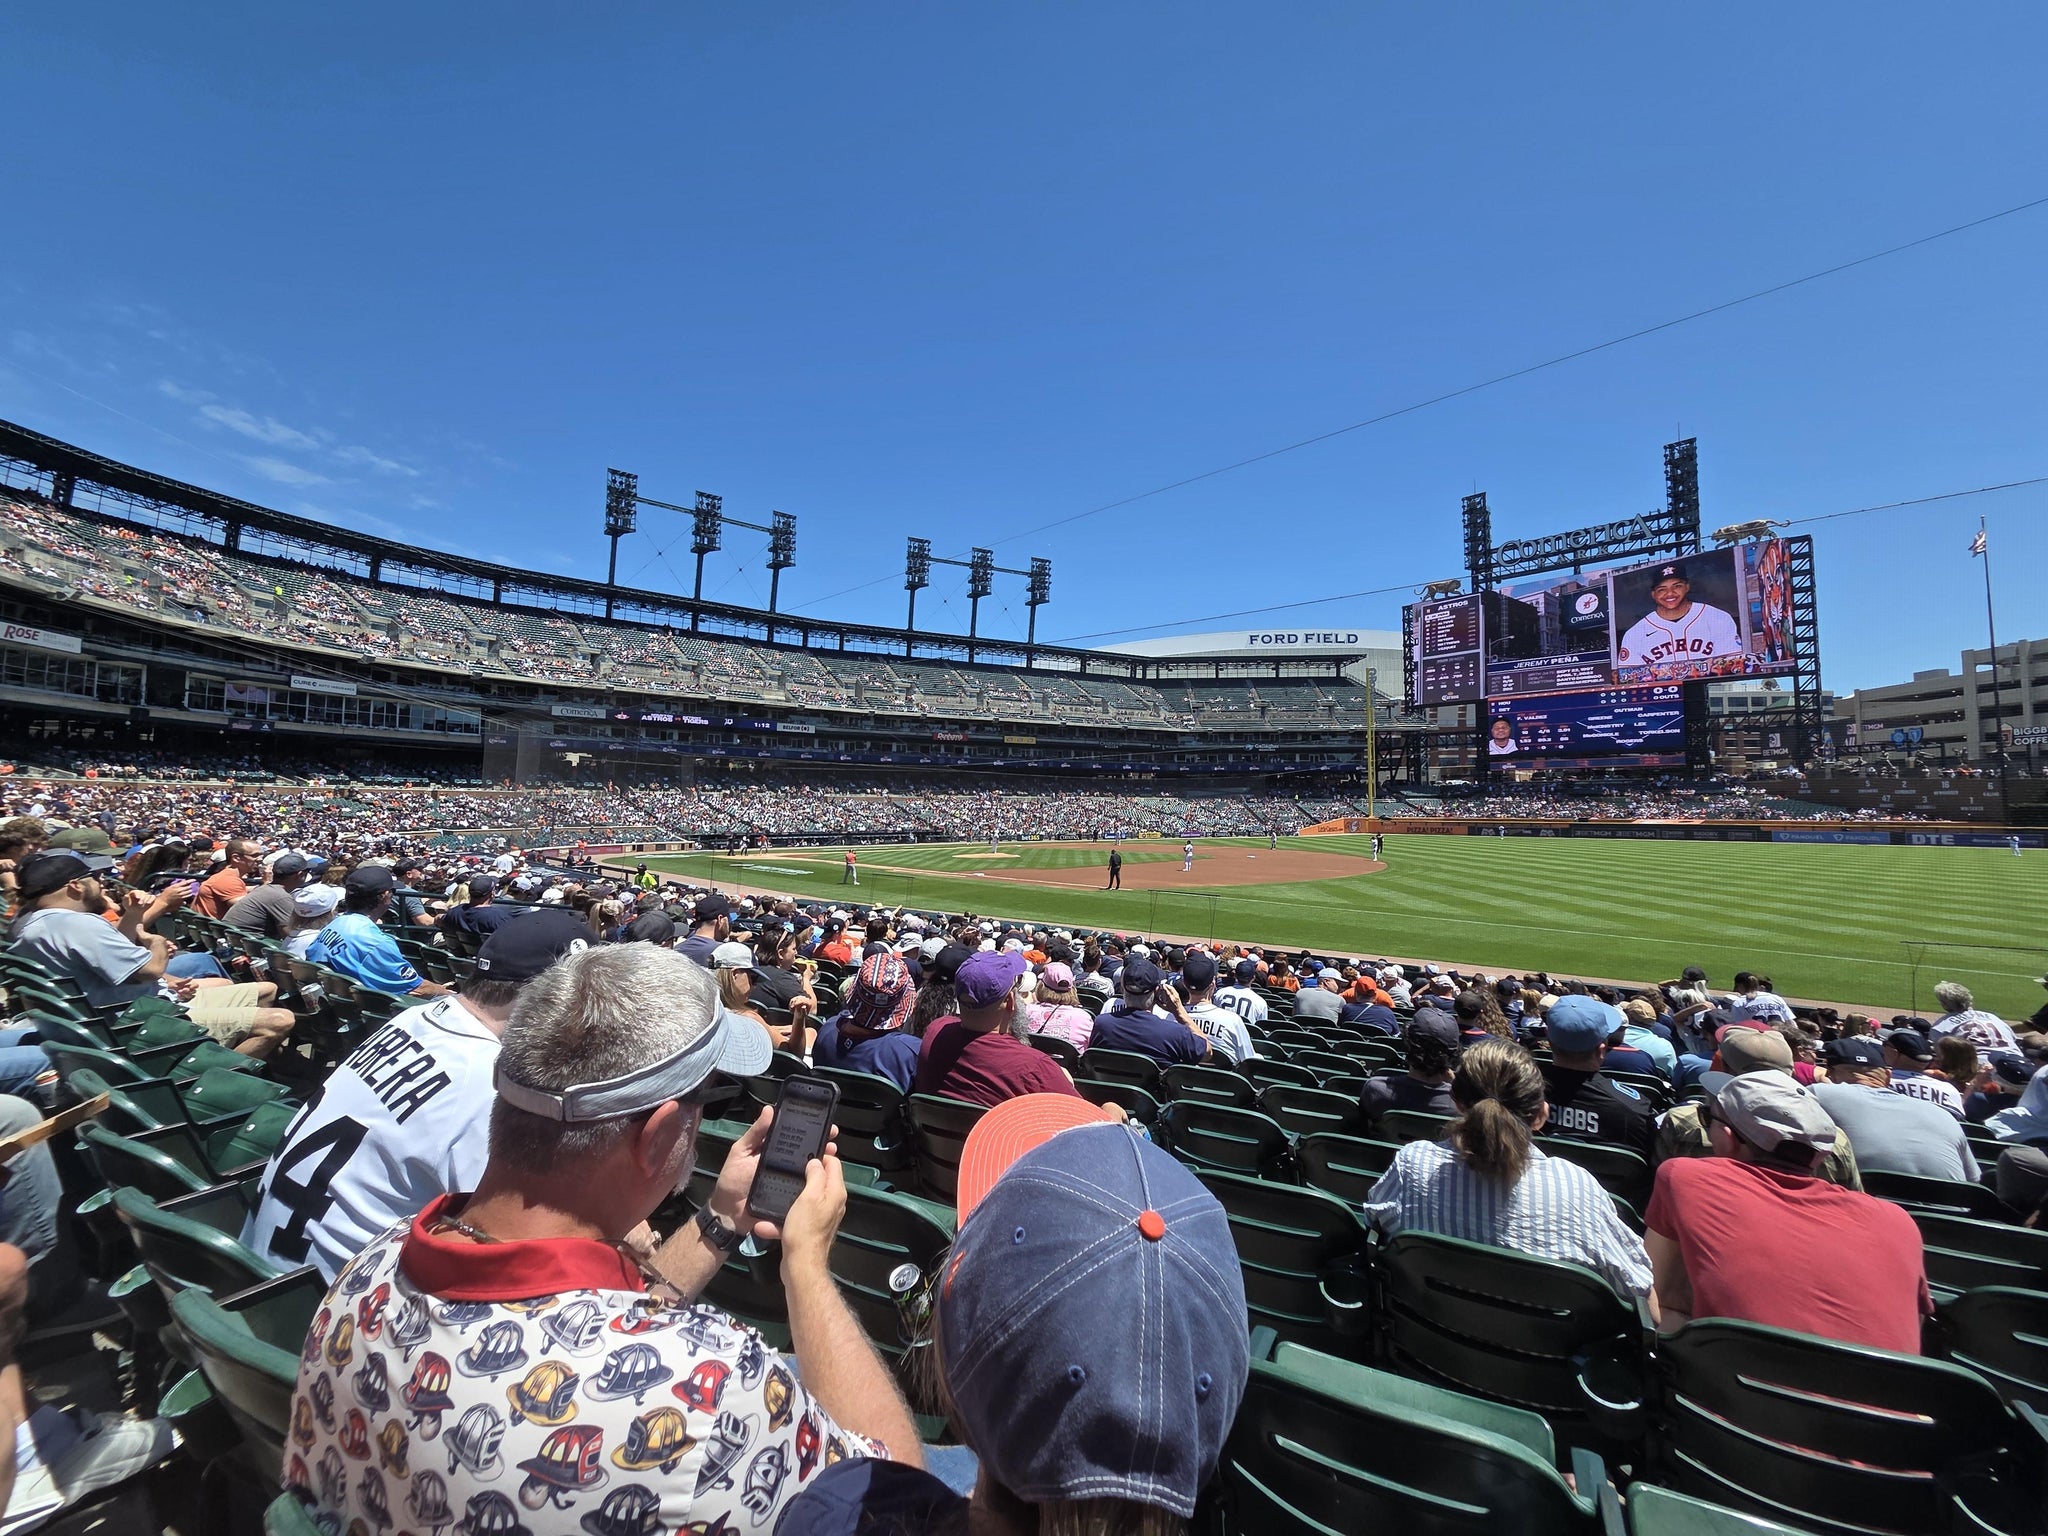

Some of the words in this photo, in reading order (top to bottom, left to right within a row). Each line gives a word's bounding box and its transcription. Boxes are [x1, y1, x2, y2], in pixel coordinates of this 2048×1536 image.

[1537, 544, 1610, 568] PARK
[1437, 600, 1469, 611] ASTROS
[4, 624, 40, 640] ROSE
[1249, 633, 1299, 645] FORD
[1304, 632, 1359, 645] FIELD
[1641, 638, 1714, 665] ASTROS
[1513, 659, 1549, 669] JEREMY
[293, 679, 311, 687] CURE
[641, 714, 673, 723] ASTROS
[683, 717, 709, 725] TIGERS
[2013, 725, 2048, 736] BIGGB
[2014, 736, 2048, 745] COFFE
[1763, 748, 1789, 757] BETMGM
[1911, 834, 1955, 845] DTE
[1222, 994, 1251, 1018] 20
[345, 1023, 453, 1126] ABRERA
[262, 1086, 370, 1264] 4
